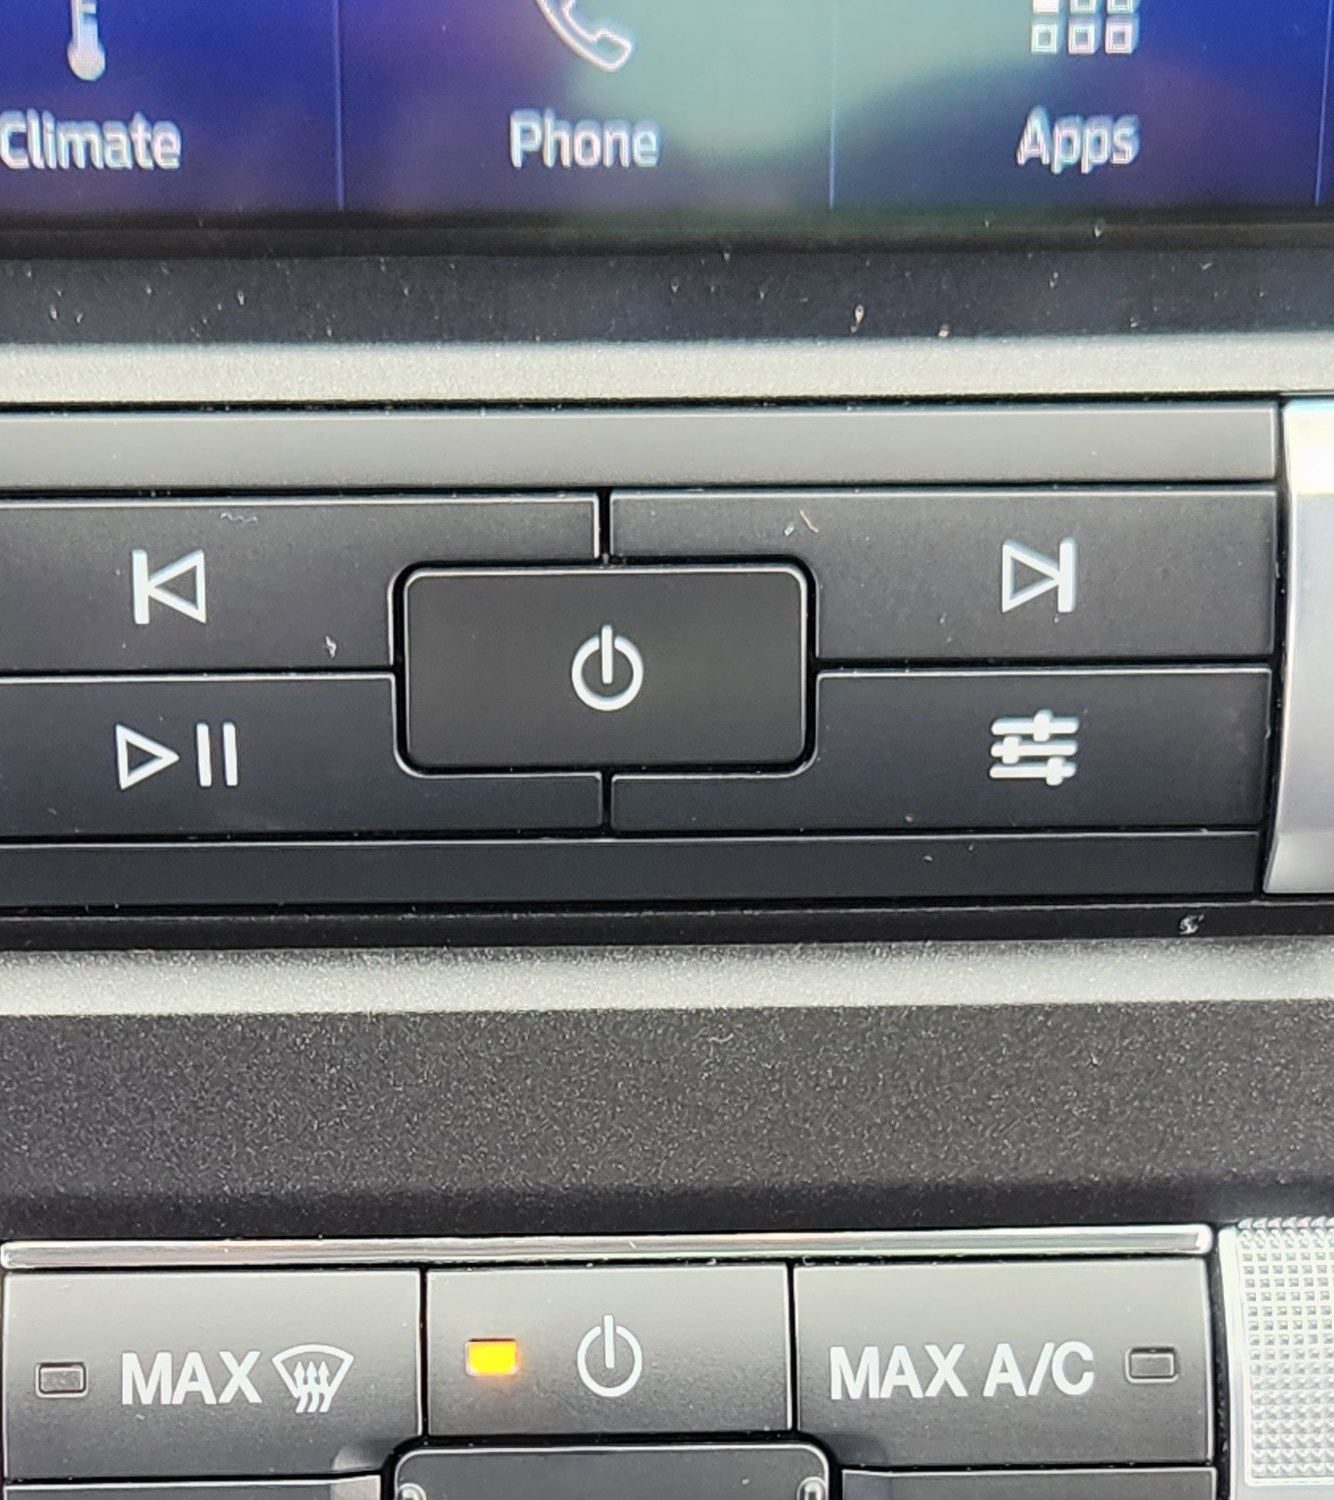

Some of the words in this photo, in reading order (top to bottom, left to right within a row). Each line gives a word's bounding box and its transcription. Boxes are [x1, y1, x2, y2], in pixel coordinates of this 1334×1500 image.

[509, 108, 660, 168] Phone
[1017, 106, 1138, 175] Apps
[121, 1353, 263, 1405] MAX
[828, 1344, 967, 1399] MAX
[983, 1341, 1096, 1396] A/C
